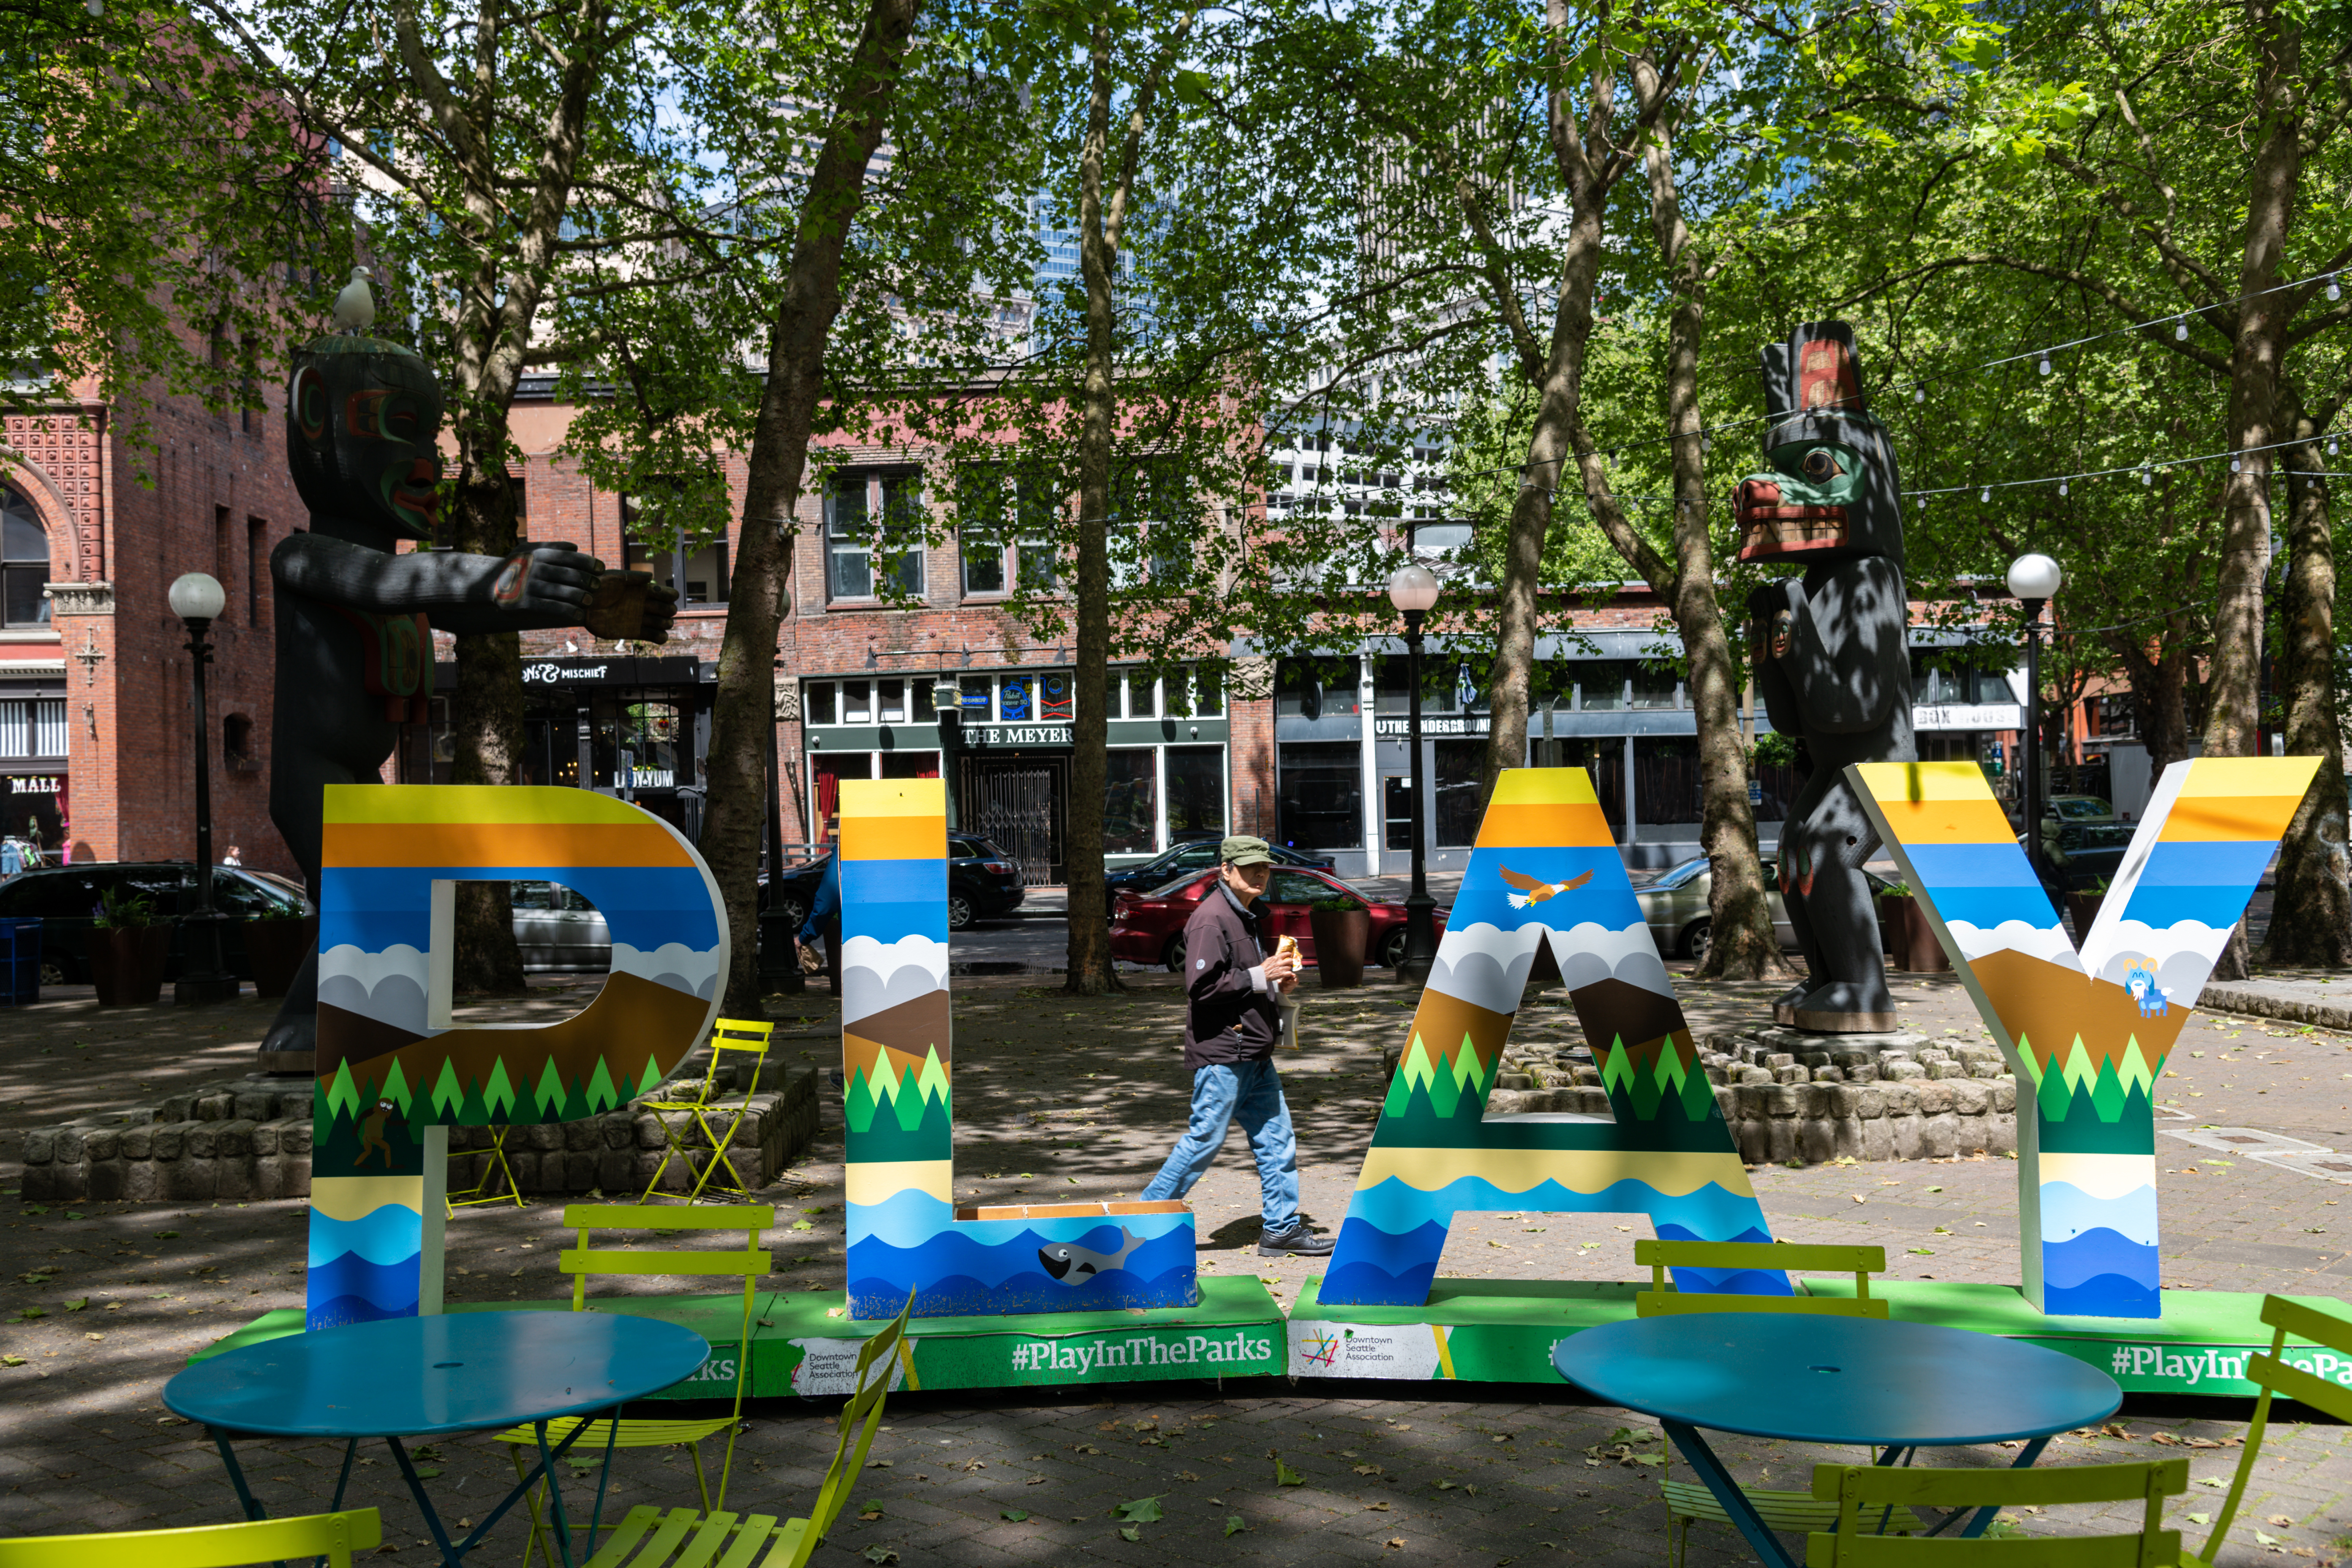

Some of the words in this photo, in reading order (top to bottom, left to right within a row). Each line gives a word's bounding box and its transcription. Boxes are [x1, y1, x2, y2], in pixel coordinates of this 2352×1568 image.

[538, 663, 560, 683] &
[561, 665, 607, 678] MISCHIEF
[1004, 690, 1021, 699] Pabst
[1918, 710, 1951, 724] BOX
[1387, 720, 1409, 733] THE
[1420, 719, 1491, 733] NDERGROUN
[961, 729, 1000, 744] THE
[1006, 727, 1074, 743] MEYER
[11, 777, 62, 794] MALL
[646, 770, 673, 787] YUM
[809, 1353, 857, 1361] Downtown
[1012, 1332, 1271, 1375] #PlayInTheParks
[1345, 1352, 1394, 1361] Association
[809, 1361, 840, 1370] Seattle
[809, 1369, 858, 1378] Association
